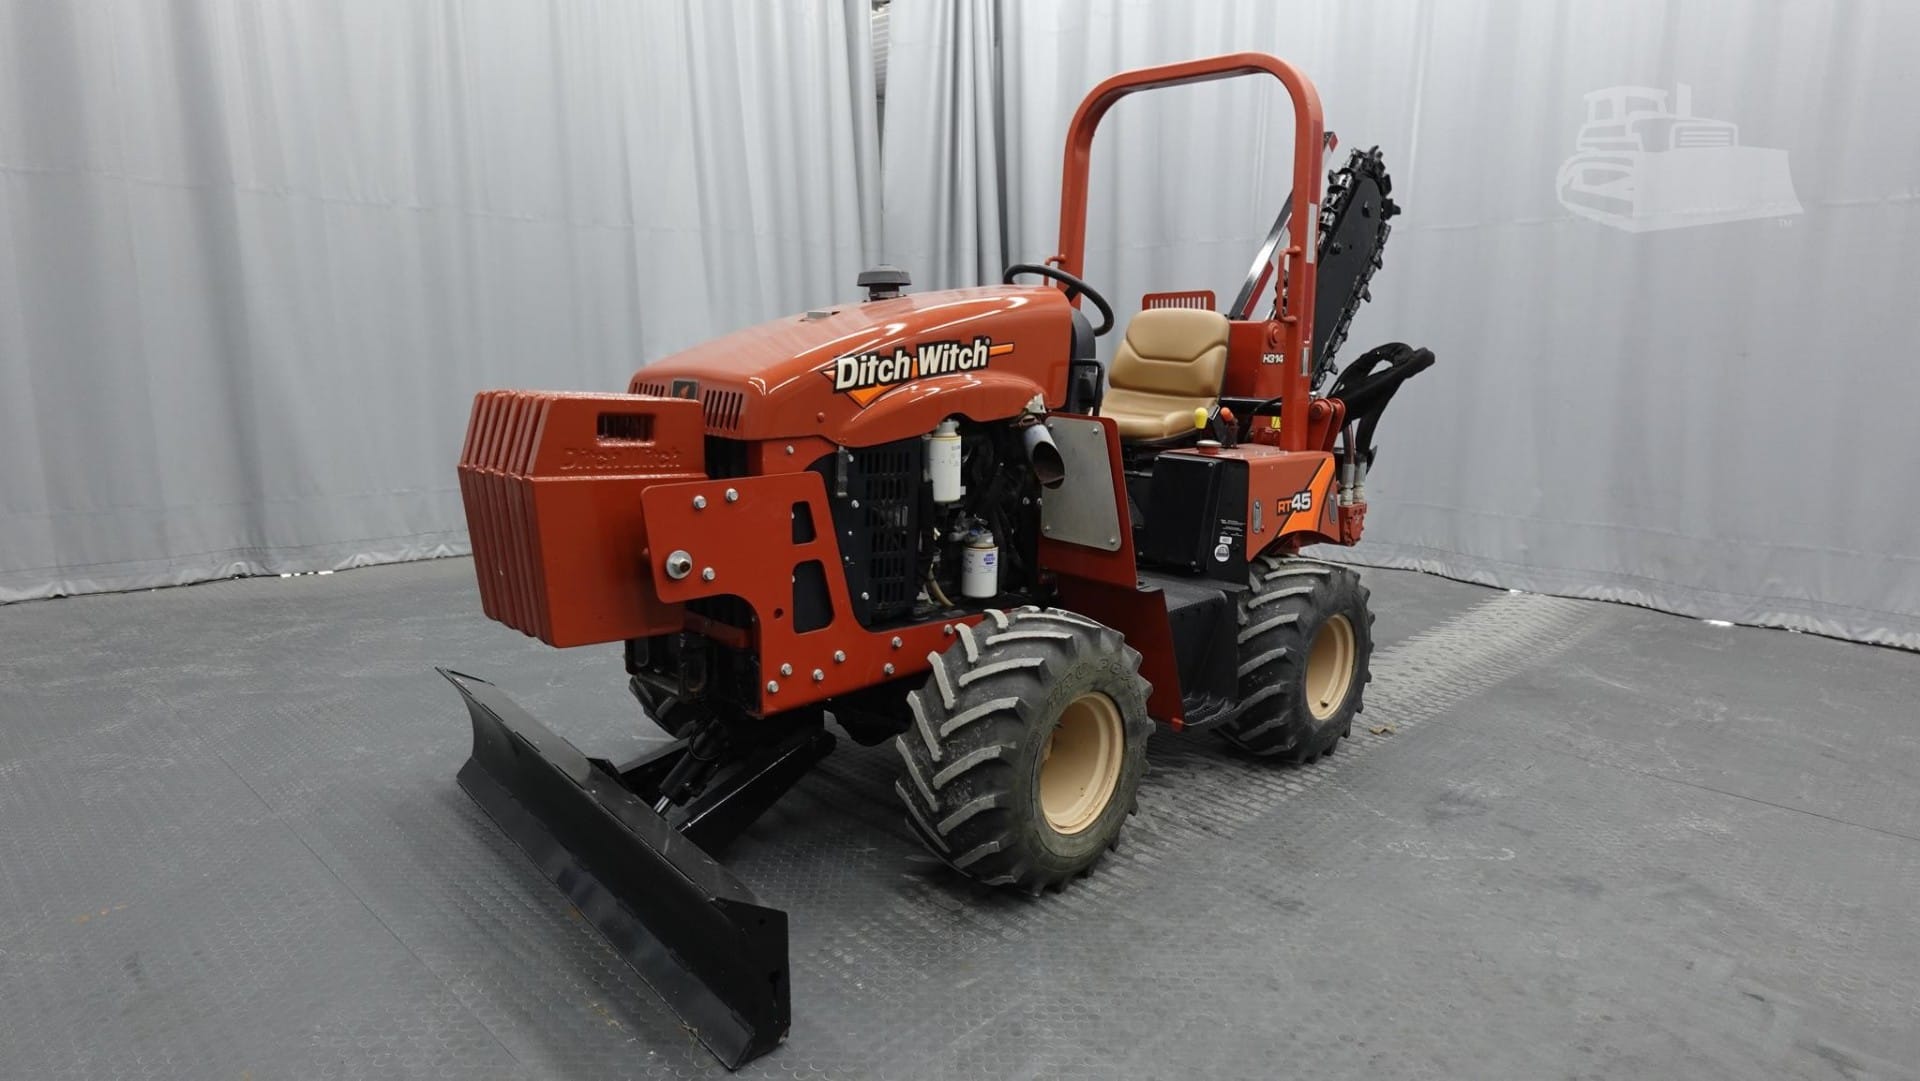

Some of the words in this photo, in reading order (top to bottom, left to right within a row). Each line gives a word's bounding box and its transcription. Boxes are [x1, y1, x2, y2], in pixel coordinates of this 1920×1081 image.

[836, 350, 910, 390] Ditch
[918, 339, 989, 376] Witch
[1278, 492, 1311, 513] RT45
